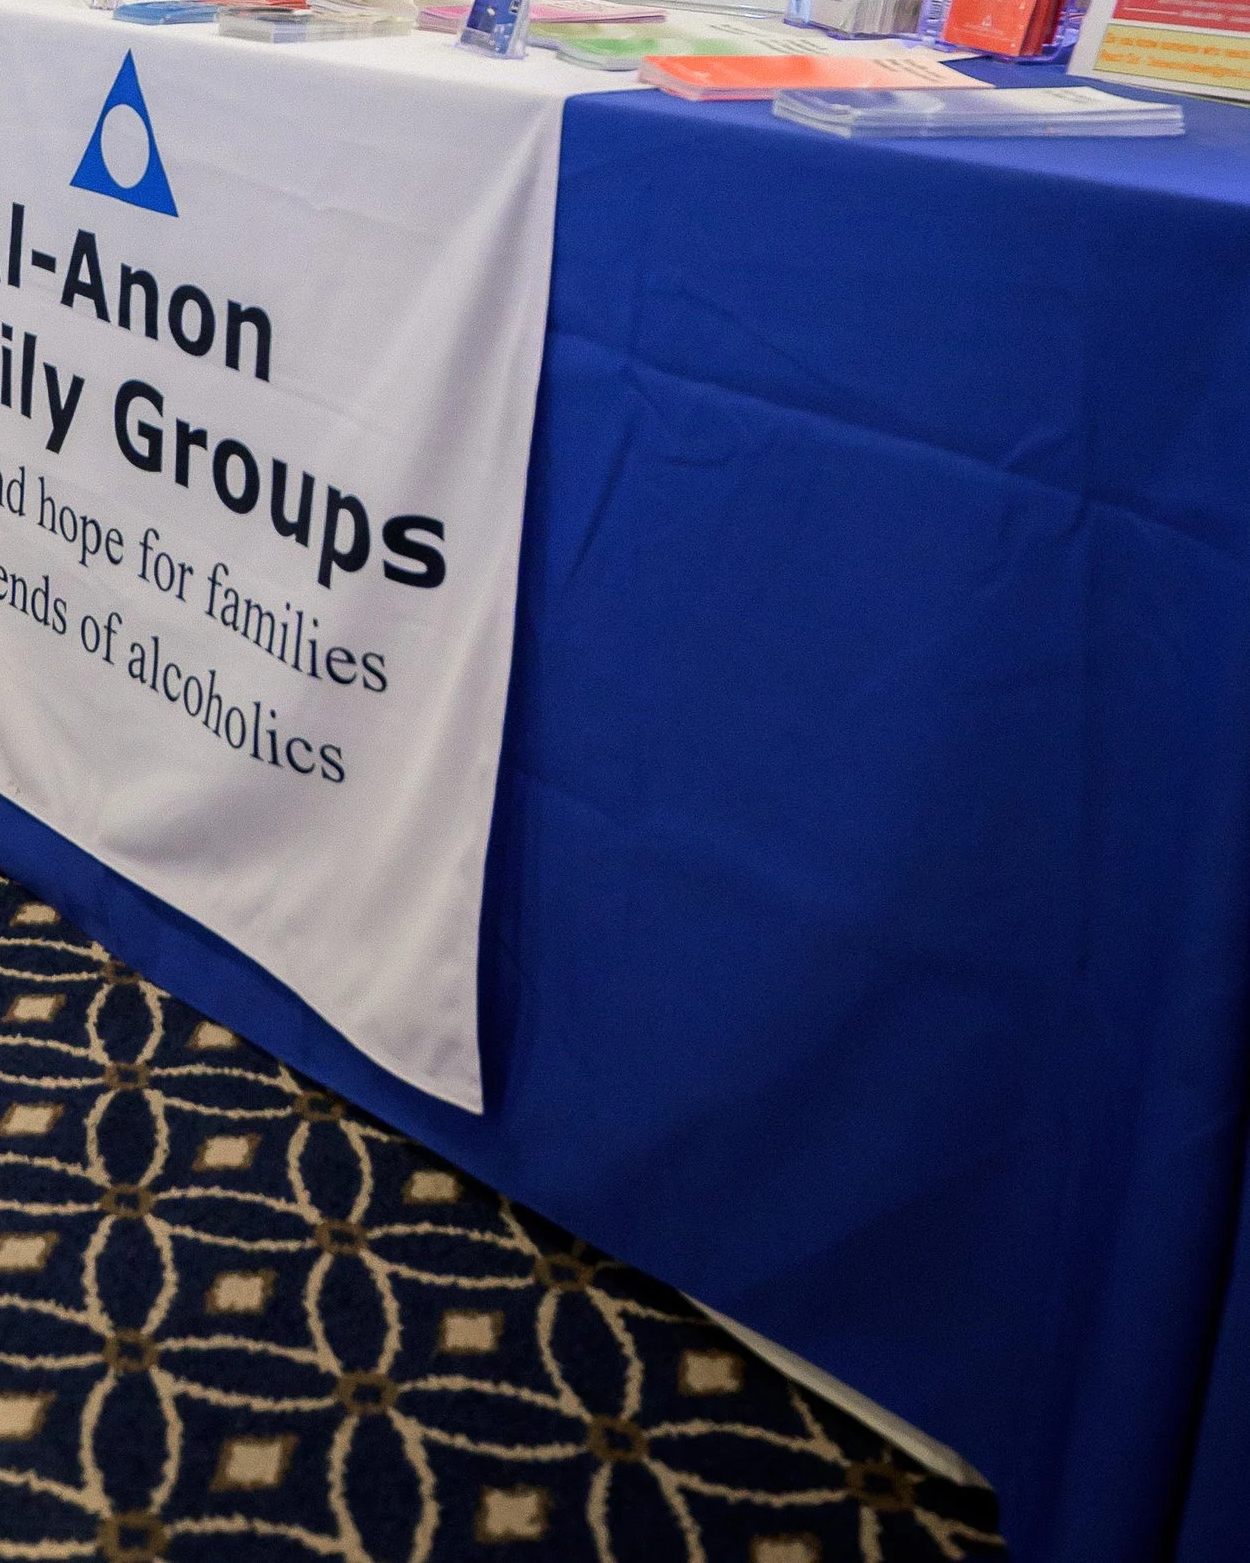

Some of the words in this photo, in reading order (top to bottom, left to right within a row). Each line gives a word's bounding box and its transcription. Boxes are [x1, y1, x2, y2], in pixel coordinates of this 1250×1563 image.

[37, 475, 124, 567] hope
[137, 527, 194, 602] for
[204, 561, 389, 694] families
[113, 379, 448, 590] Groups
[80, 612, 122, 666] of
[128, 635, 346, 784] alcoholics
